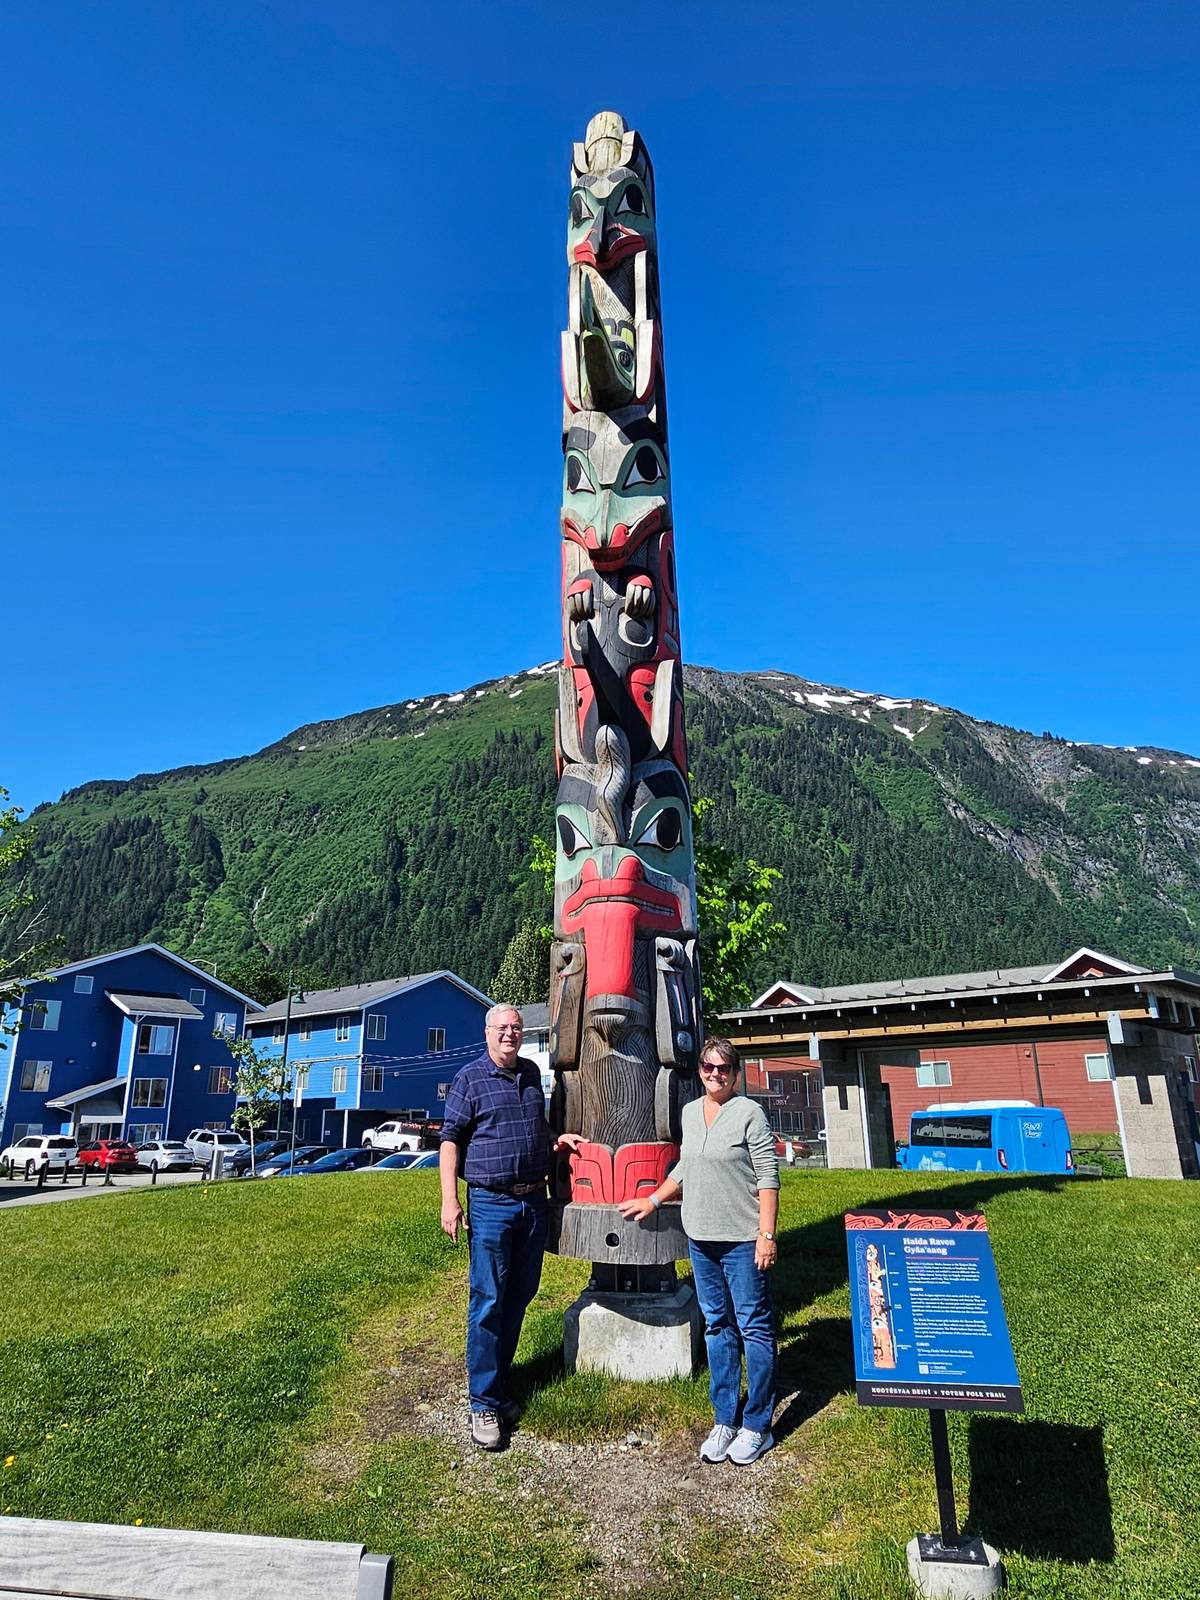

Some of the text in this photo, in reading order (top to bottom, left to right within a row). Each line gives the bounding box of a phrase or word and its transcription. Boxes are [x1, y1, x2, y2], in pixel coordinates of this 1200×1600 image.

[903, 1237, 956, 1246] Haida Raven
[940, 1389, 965, 1397] TOTEM
[985, 1391, 1007, 1399] TRAIL
